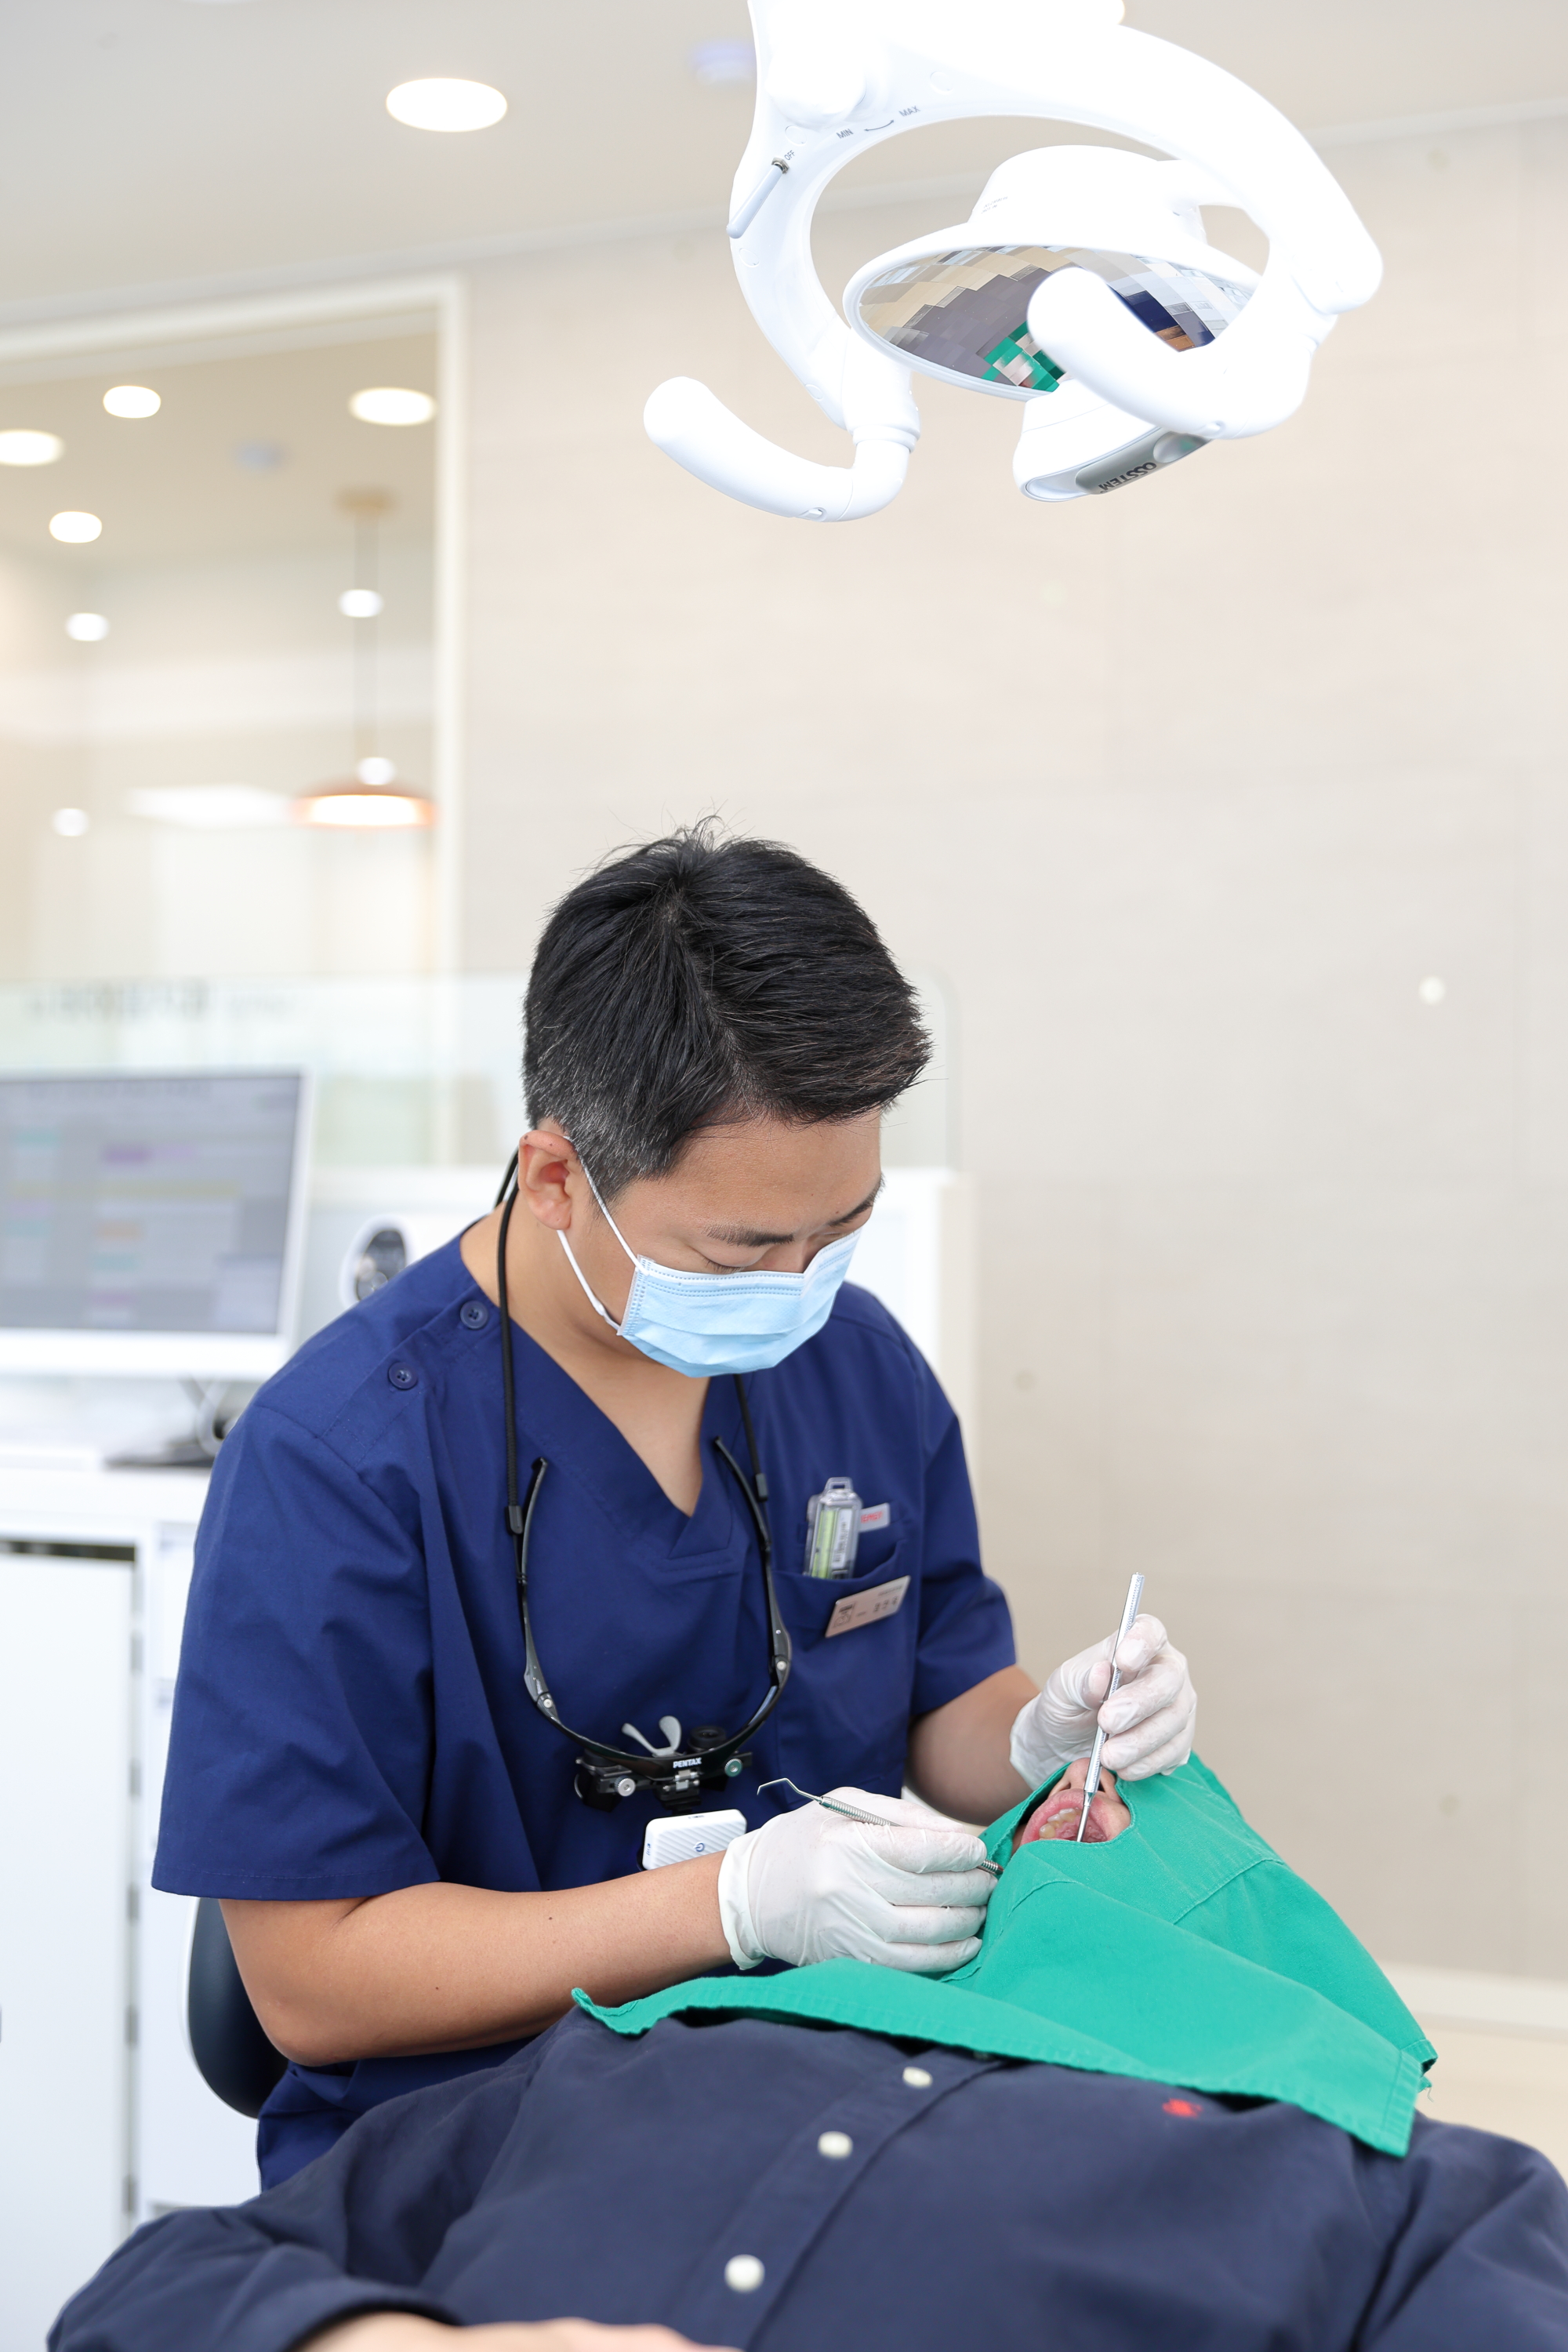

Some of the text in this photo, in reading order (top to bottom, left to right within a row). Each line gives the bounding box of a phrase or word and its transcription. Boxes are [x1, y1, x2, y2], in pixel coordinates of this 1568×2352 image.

[898, 105, 921, 117] MAX
[836, 129, 855, 139] MIN
[784, 150, 795, 161] OFF
[1098, 462, 1157, 492] OSSTEM
[673, 1757, 702, 1769] PENTAX
